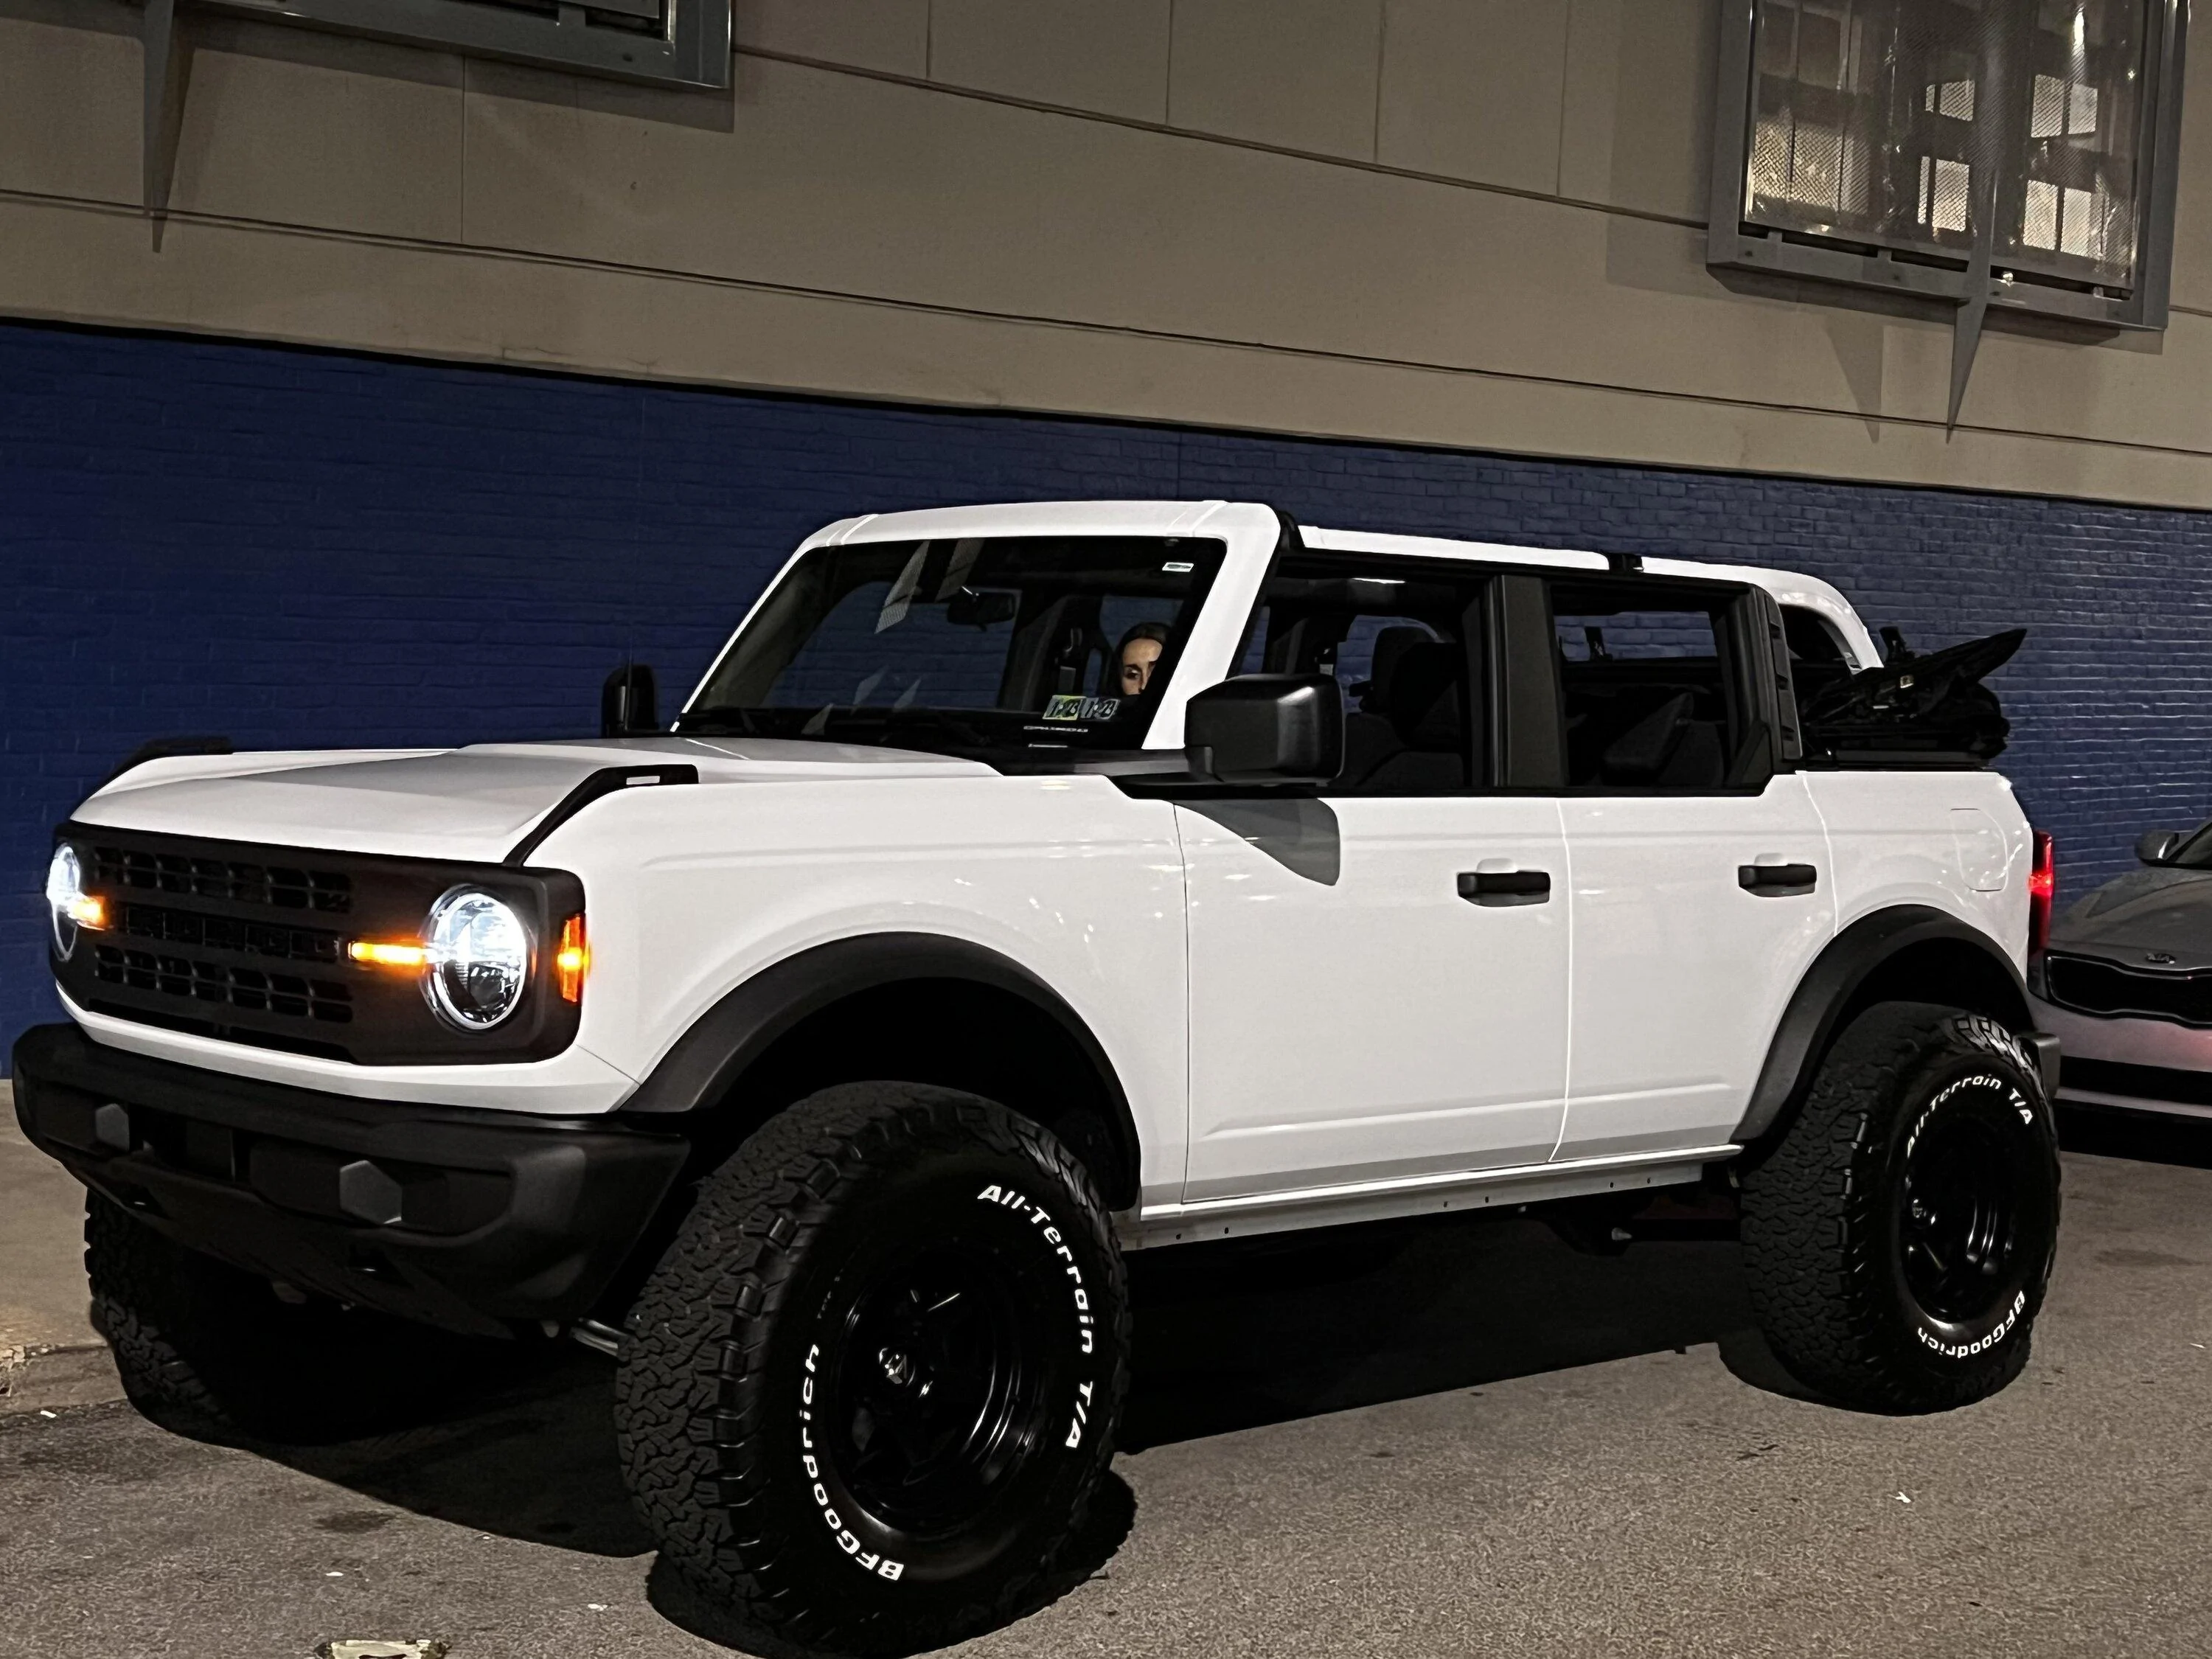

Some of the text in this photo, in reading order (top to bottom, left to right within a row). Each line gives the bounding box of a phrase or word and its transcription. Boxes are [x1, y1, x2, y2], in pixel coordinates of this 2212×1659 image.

[1907, 1073, 2034, 1159] All-Terrain T/A
[977, 1184, 1094, 1450] All-Terrain T/A
[1917, 1290, 2026, 1360] BFGoodrich
[799, 1343, 905, 1582] BFGoodrich
